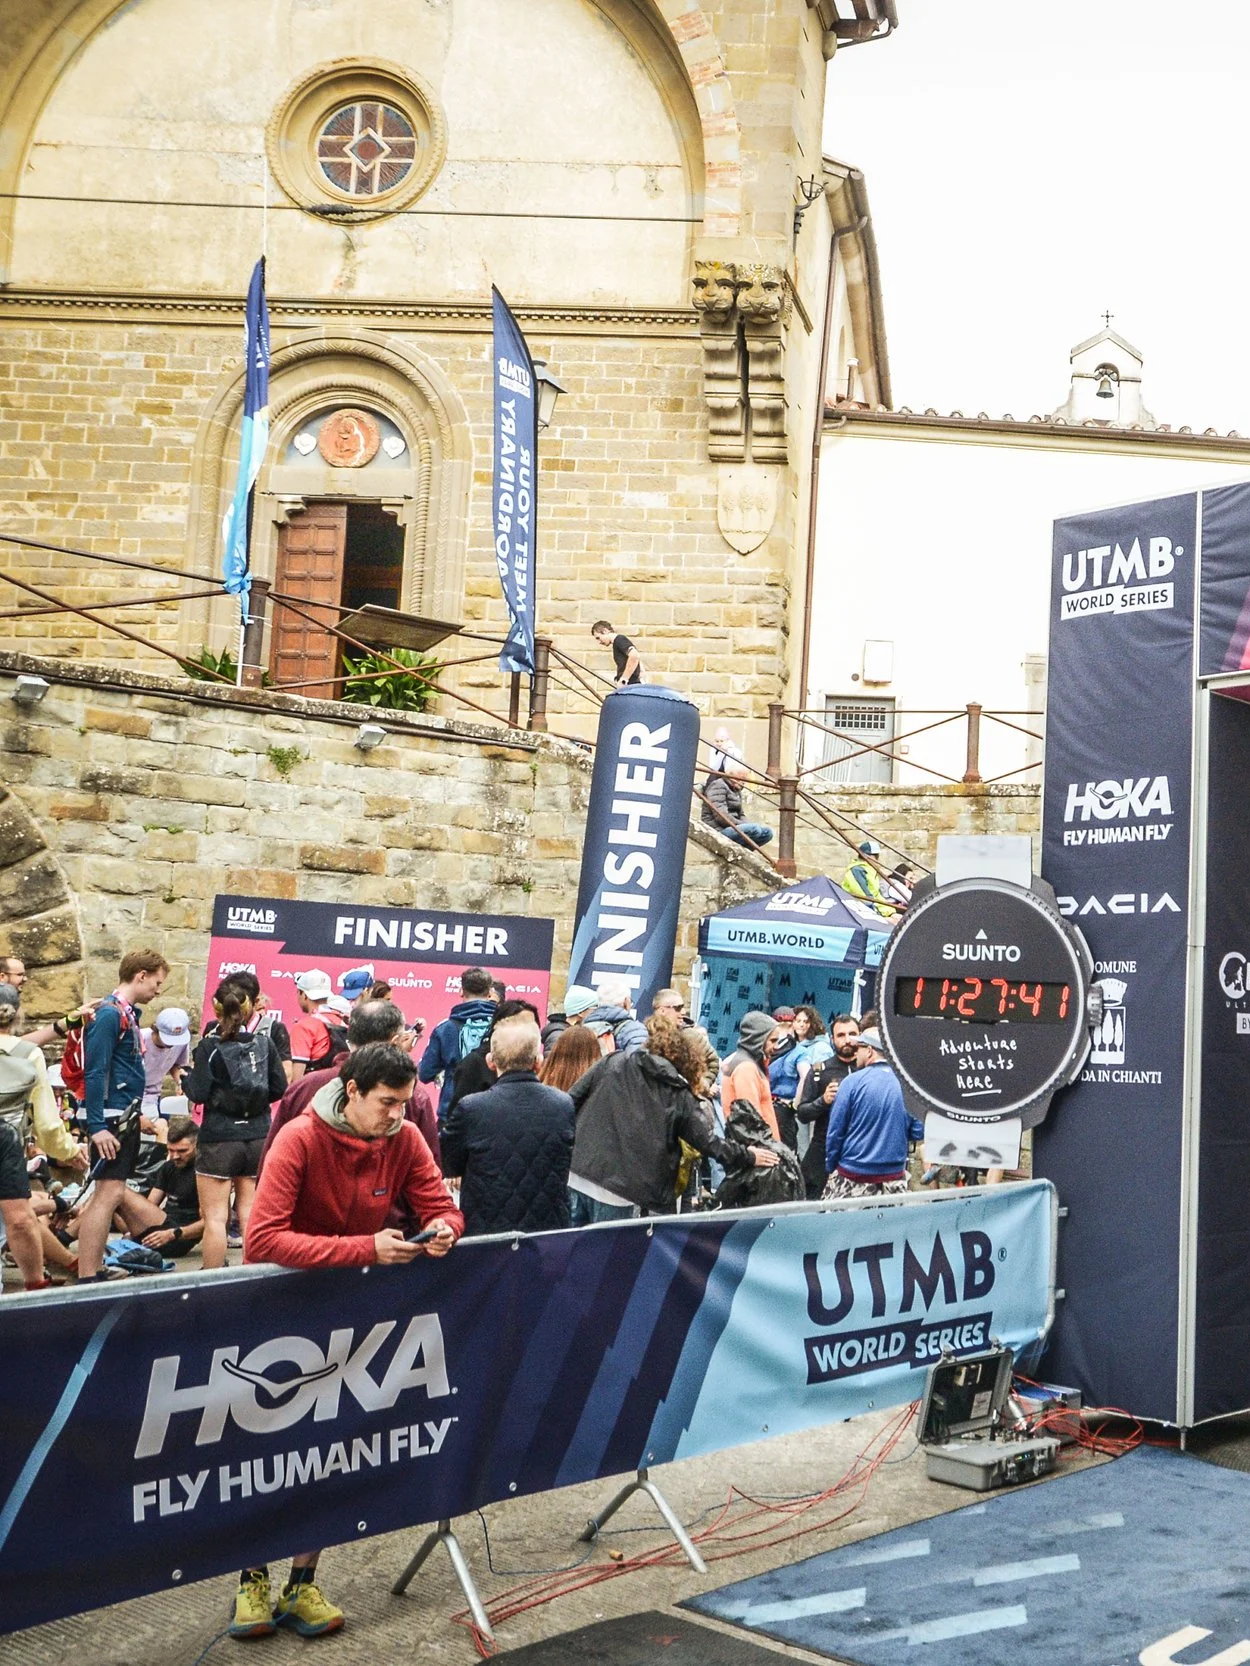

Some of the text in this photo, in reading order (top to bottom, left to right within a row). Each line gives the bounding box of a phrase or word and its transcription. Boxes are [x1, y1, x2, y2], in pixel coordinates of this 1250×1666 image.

[1061, 536, 1175, 592] UTMB
[1066, 589, 1168, 613] WORLD SERIES
[1064, 775, 1172, 823] HOKA
[1063, 823, 1172, 846] FLY HUMAN FLY
[591, 721, 672, 1014] INISHER
[771, 892, 835, 909] UTMB
[1056, 892, 1181, 915] DACIA
[228, 906, 276, 923] UTMB
[334, 916, 509, 956] FINISHER
[728, 930, 825, 949] UTMB.WORLD
[942, 943, 1021, 962] SUUNTO
[1094, 961, 1137, 973] OMUNE
[388, 978, 432, 989] SUUNTO
[505, 985, 542, 993] ACIA
[914, 976, 1069, 1018] 11:27:41
[1098, 1070, 1111, 1082] IN
[1112, 1071, 1162, 1084] CHIANTI
[946, 1111, 1002, 1123] SUUNTO
[803, 1229, 996, 1326] UTMB
[812, 1322, 985, 1373] WORLD SERIES
[134, 1312, 450, 1459] HOKA
[133, 1418, 452, 1523] FLY HUMAN FLY
